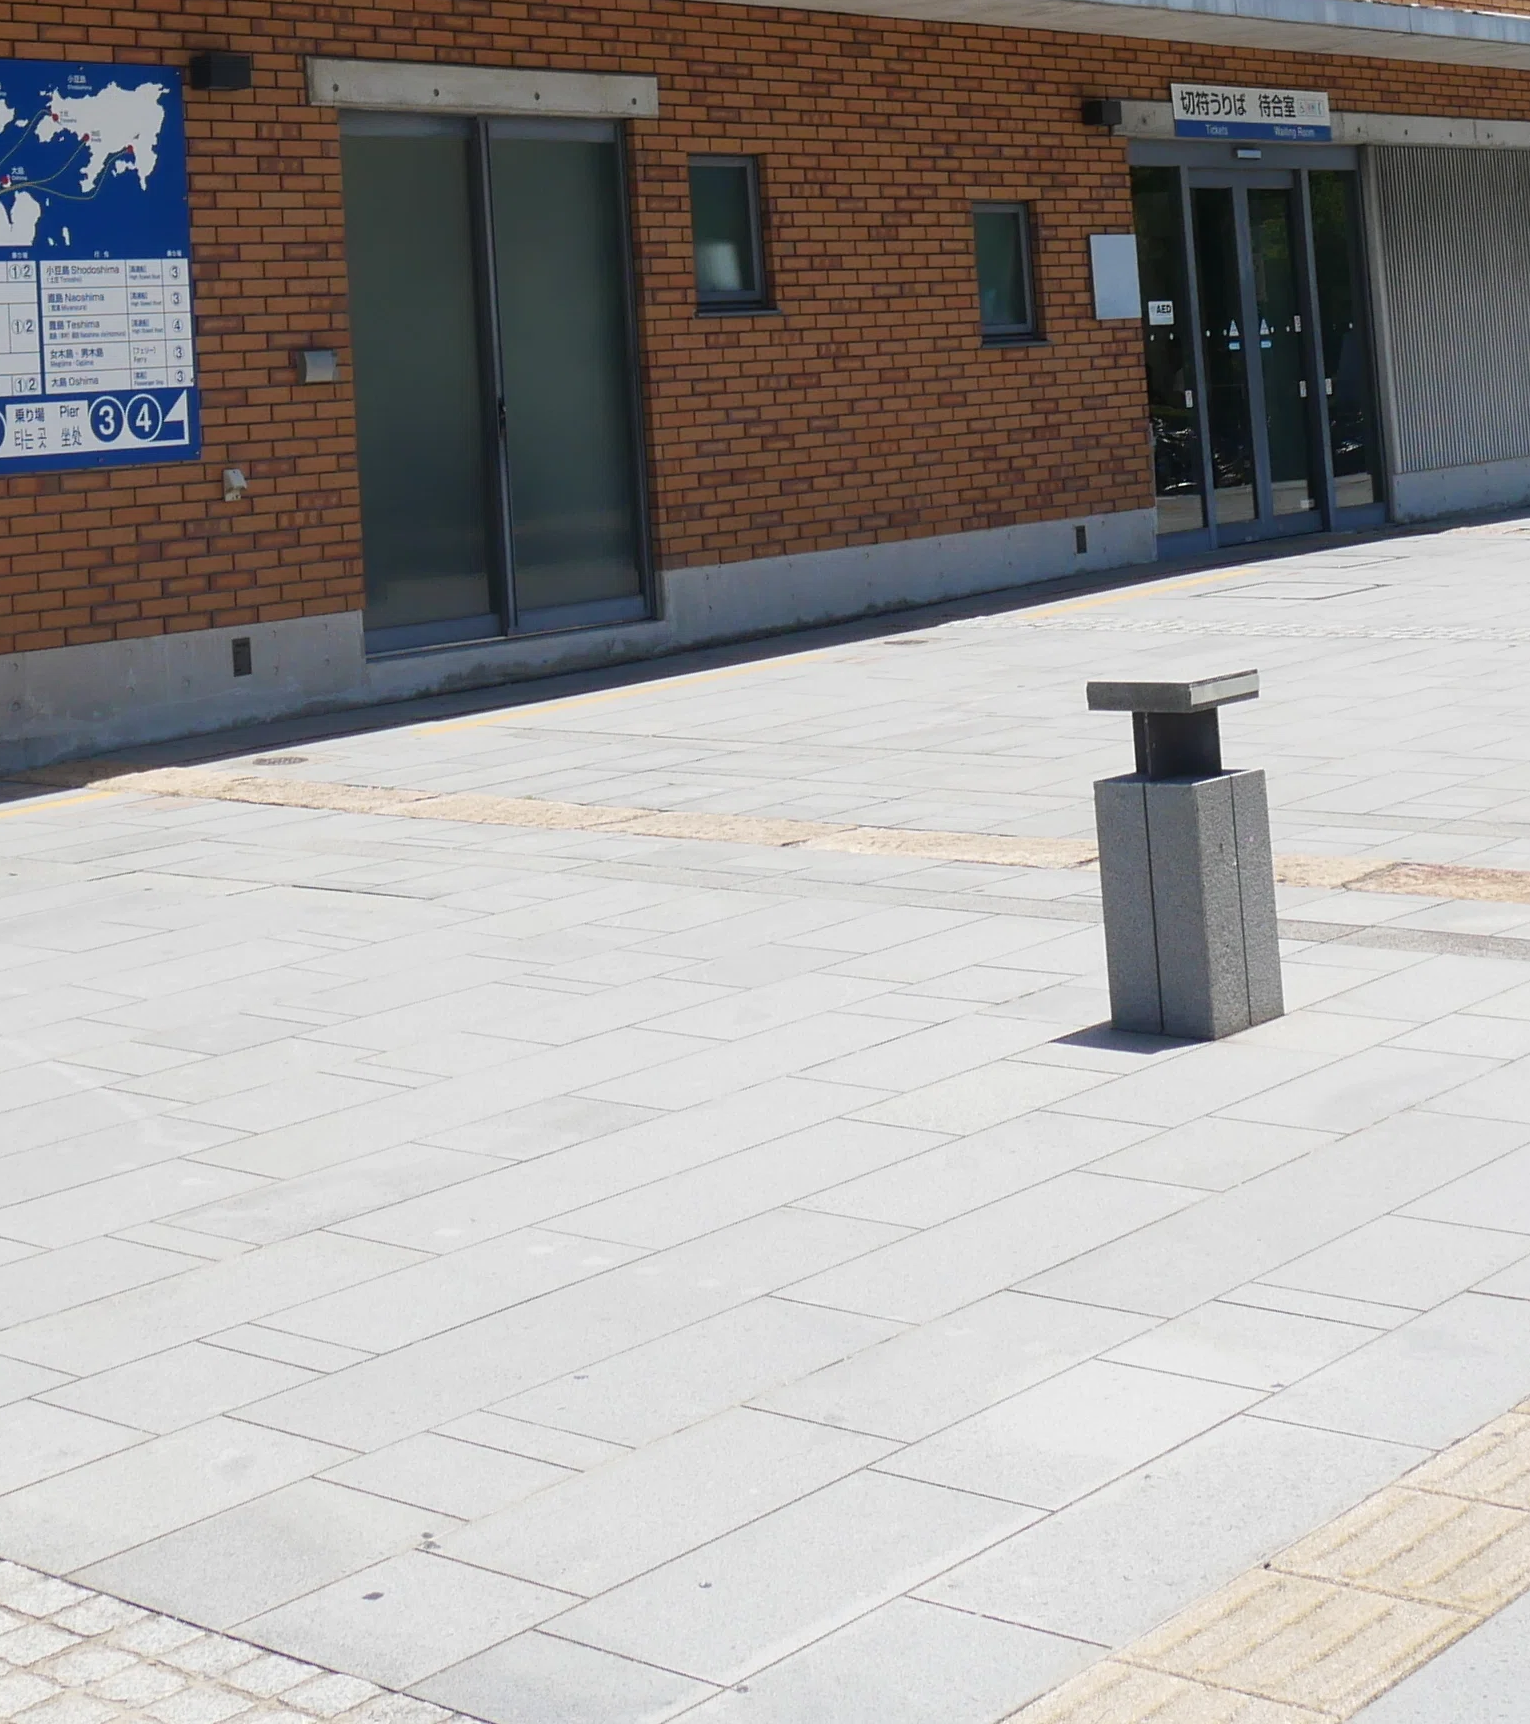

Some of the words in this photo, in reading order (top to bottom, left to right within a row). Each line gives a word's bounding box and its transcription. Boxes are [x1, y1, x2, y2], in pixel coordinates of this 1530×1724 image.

[1180, 89, 1247, 116] 切符うりば
[1258, 93, 1297, 118] 待合室
[1205, 123, 1229, 136] Tickets
[71, 265, 120, 275] Shodoshima
[64, 292, 105, 302] Naoshima
[1156, 304, 1172, 314] AED
[66, 319, 100, 329] Teshima
[51, 376, 67, 387] 大島
[68, 376, 99, 386] Oshima
[14, 407, 45, 423] 乗り場
[59, 404, 80, 418] Pier
